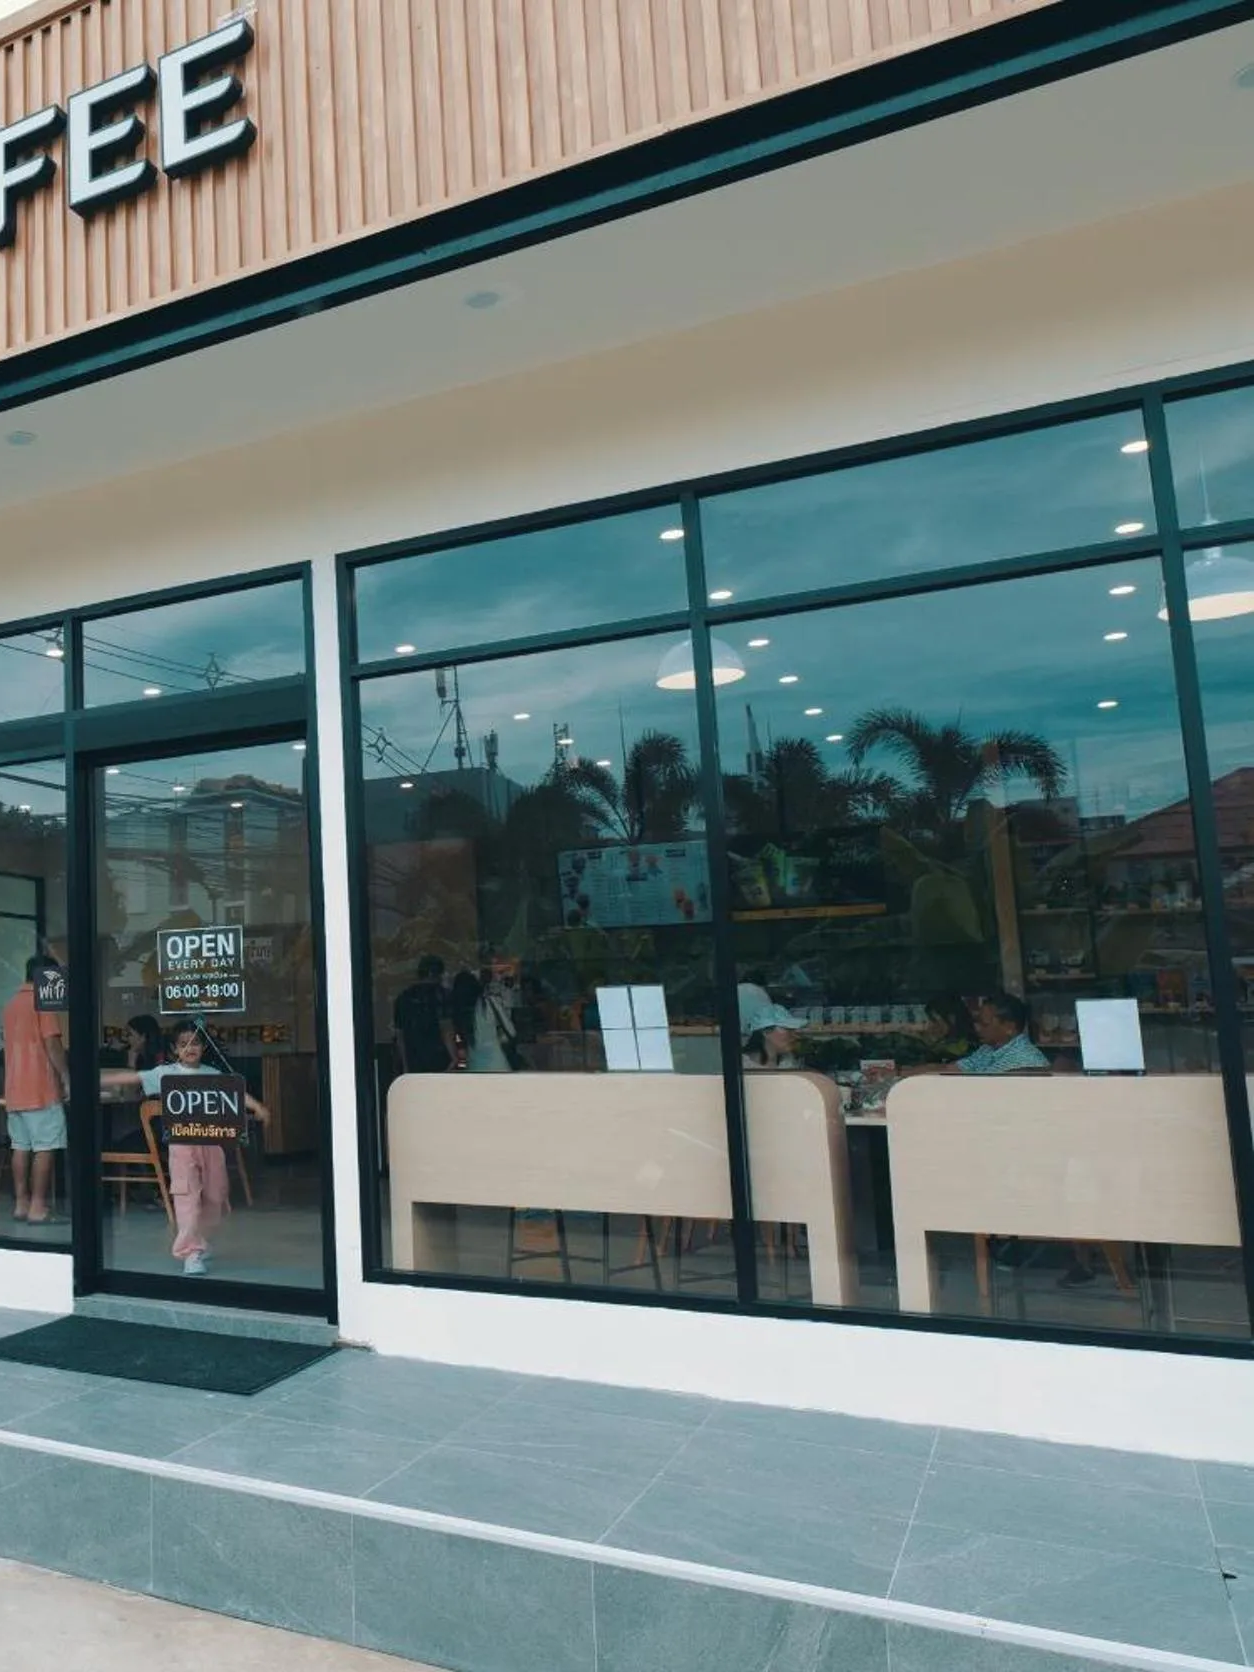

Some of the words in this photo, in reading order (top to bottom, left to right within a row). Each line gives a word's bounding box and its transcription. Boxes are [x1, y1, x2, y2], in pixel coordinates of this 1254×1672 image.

[166, 932, 235, 959] OPEN
[168, 959, 207, 971] EVERY
[211, 957, 235, 968] DAY
[166, 1089, 239, 1116] OPEN
